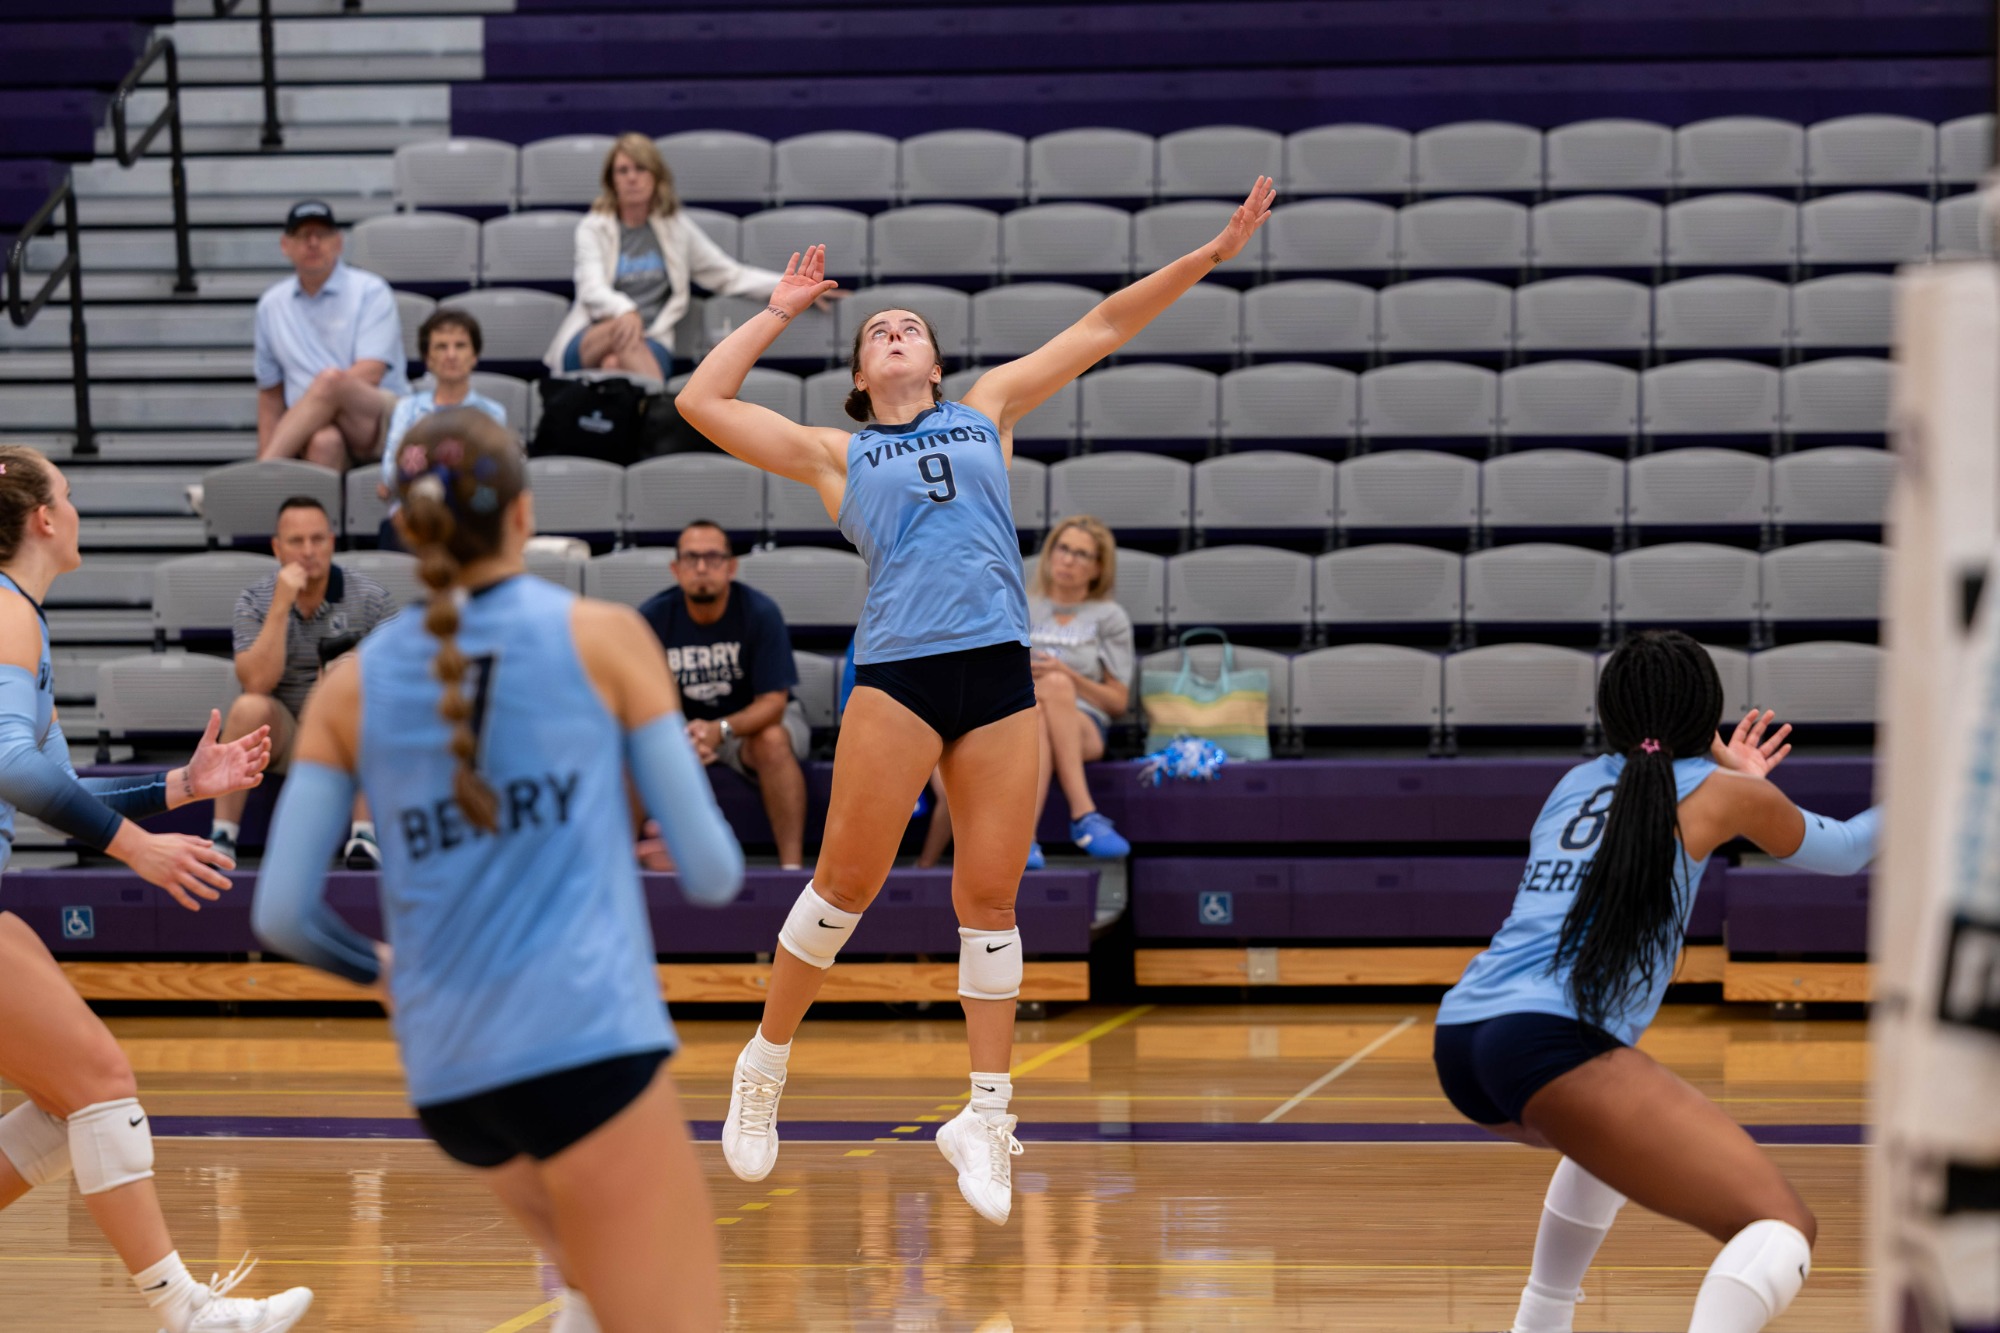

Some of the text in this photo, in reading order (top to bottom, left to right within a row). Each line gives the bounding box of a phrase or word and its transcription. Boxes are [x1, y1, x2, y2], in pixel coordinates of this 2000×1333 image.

[918, 452, 957, 503] 9
[667, 642, 741, 671] BERRY
[399, 771, 580, 862] BERY
[1559, 784, 1618, 851] 8
